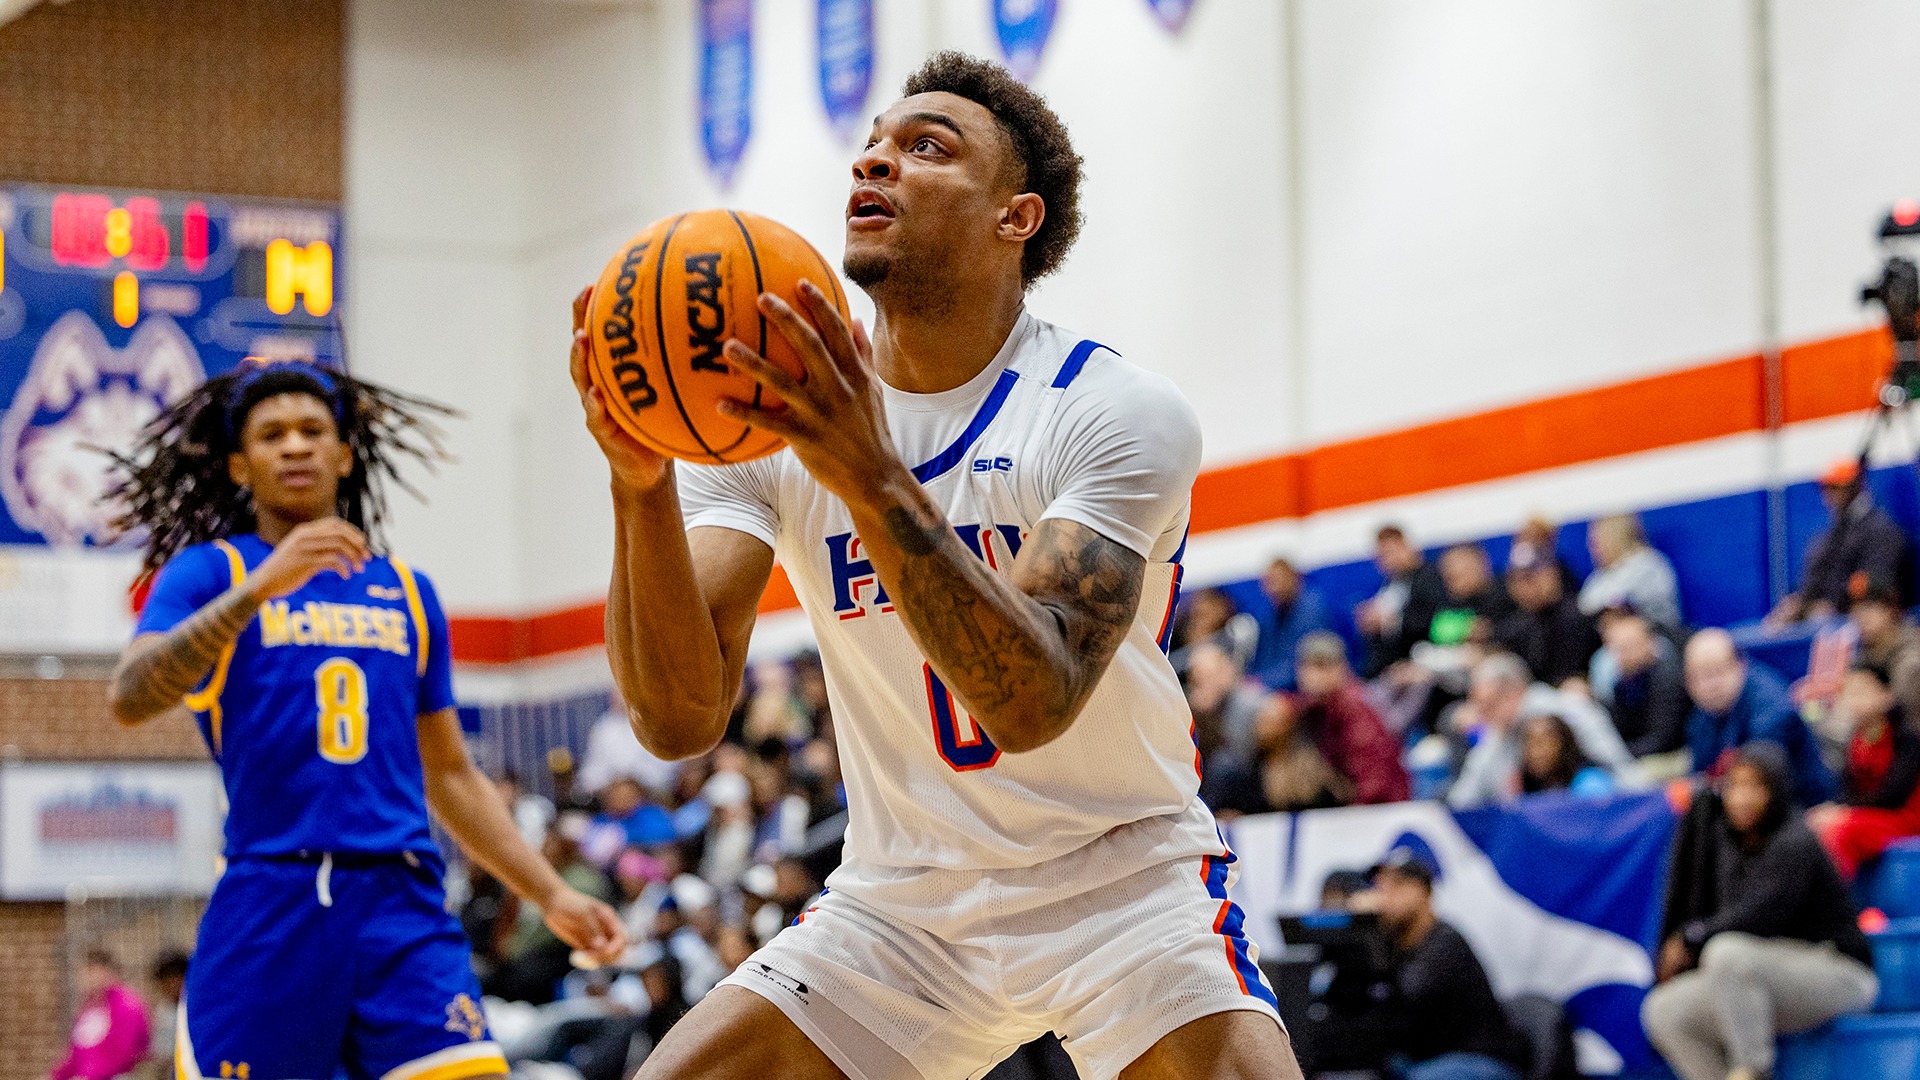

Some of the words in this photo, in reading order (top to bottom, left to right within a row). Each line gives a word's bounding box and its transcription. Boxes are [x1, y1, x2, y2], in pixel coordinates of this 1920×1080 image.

[603, 240, 658, 416] Wilson
[684, 252, 729, 375] NCAA
[314, 656, 370, 765] 8
